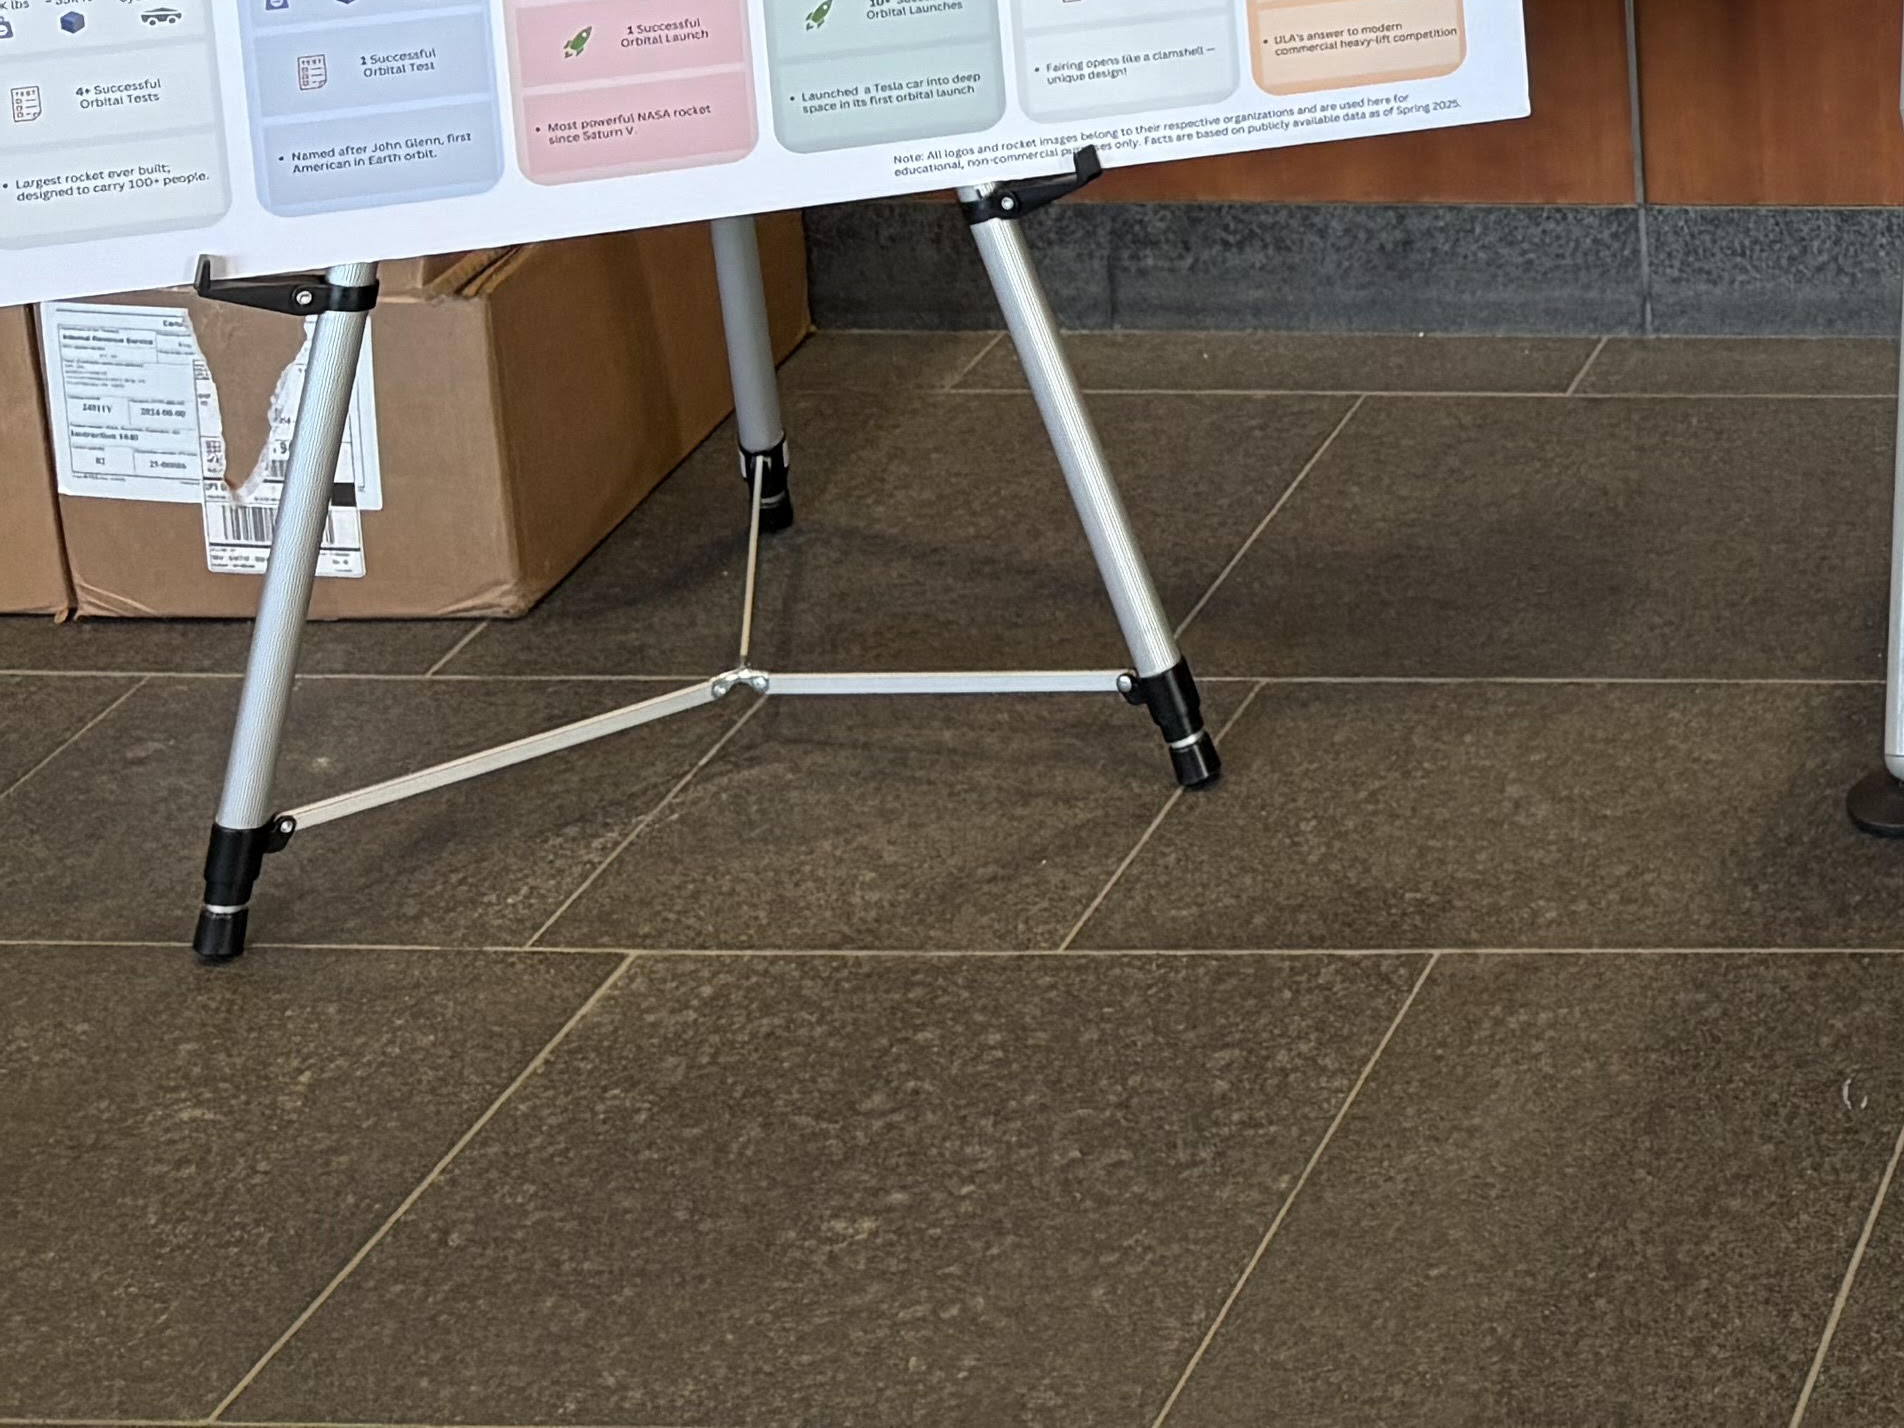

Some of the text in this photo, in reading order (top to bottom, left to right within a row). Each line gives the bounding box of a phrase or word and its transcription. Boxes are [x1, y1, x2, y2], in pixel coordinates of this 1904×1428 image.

[927, 150, 943, 161] All
[944, 146, 976, 161] logos
[977, 142, 999, 155] and
[1080, 127, 1119, 143] belong
[1120, 127, 1133, 137] to
[1135, 123, 1161, 135] their
[1163, 116, 1221, 132] respective
[1222, 106, 1295, 125] organizations
[1296, 103, 1318, 116] and
[1319, 101, 1338, 112] are
[1339, 97, 1366, 110] used
[1367, 94, 1392, 107] here
[1393, 92, 1410, 104] for
